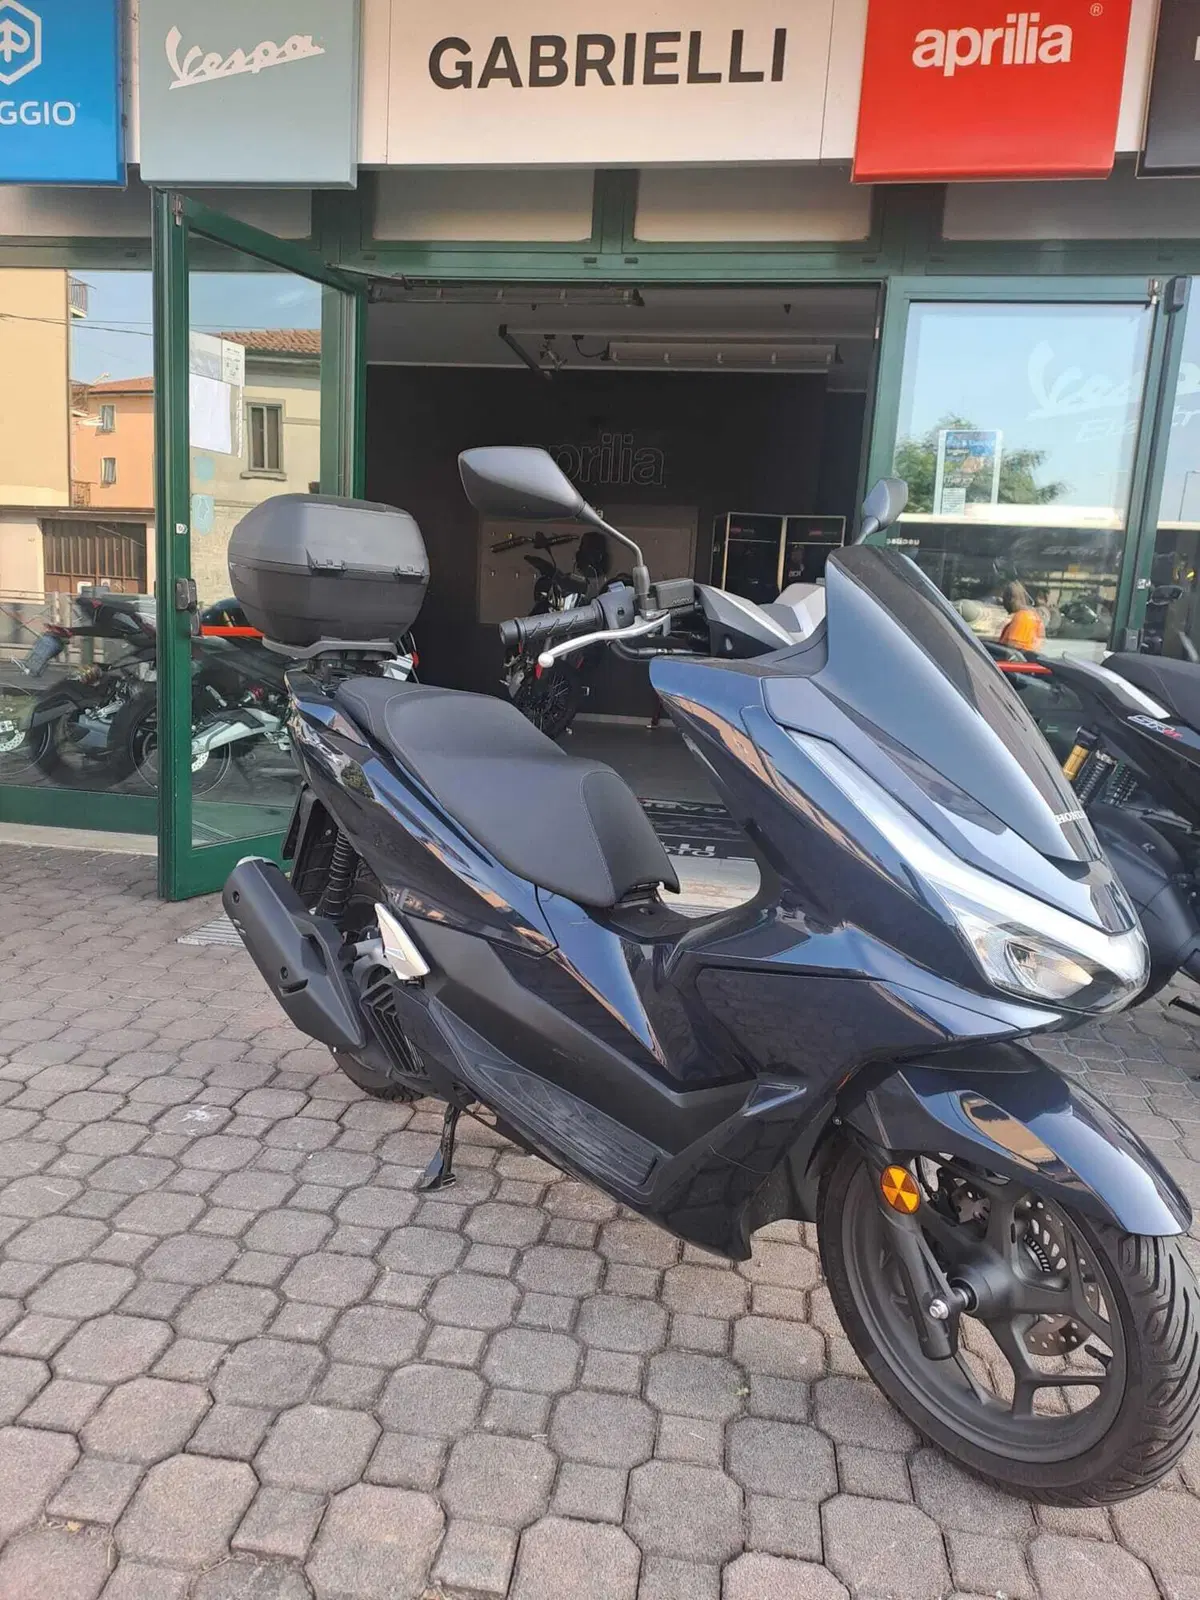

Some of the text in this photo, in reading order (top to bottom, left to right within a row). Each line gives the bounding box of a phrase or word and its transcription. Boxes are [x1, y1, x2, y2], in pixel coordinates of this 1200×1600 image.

[165, 25, 325, 90] Vespa
[428, 28, 787, 90] GABRIELLI
[912, 12, 1073, 77] aprilia
[523, 433, 665, 485] prilia
